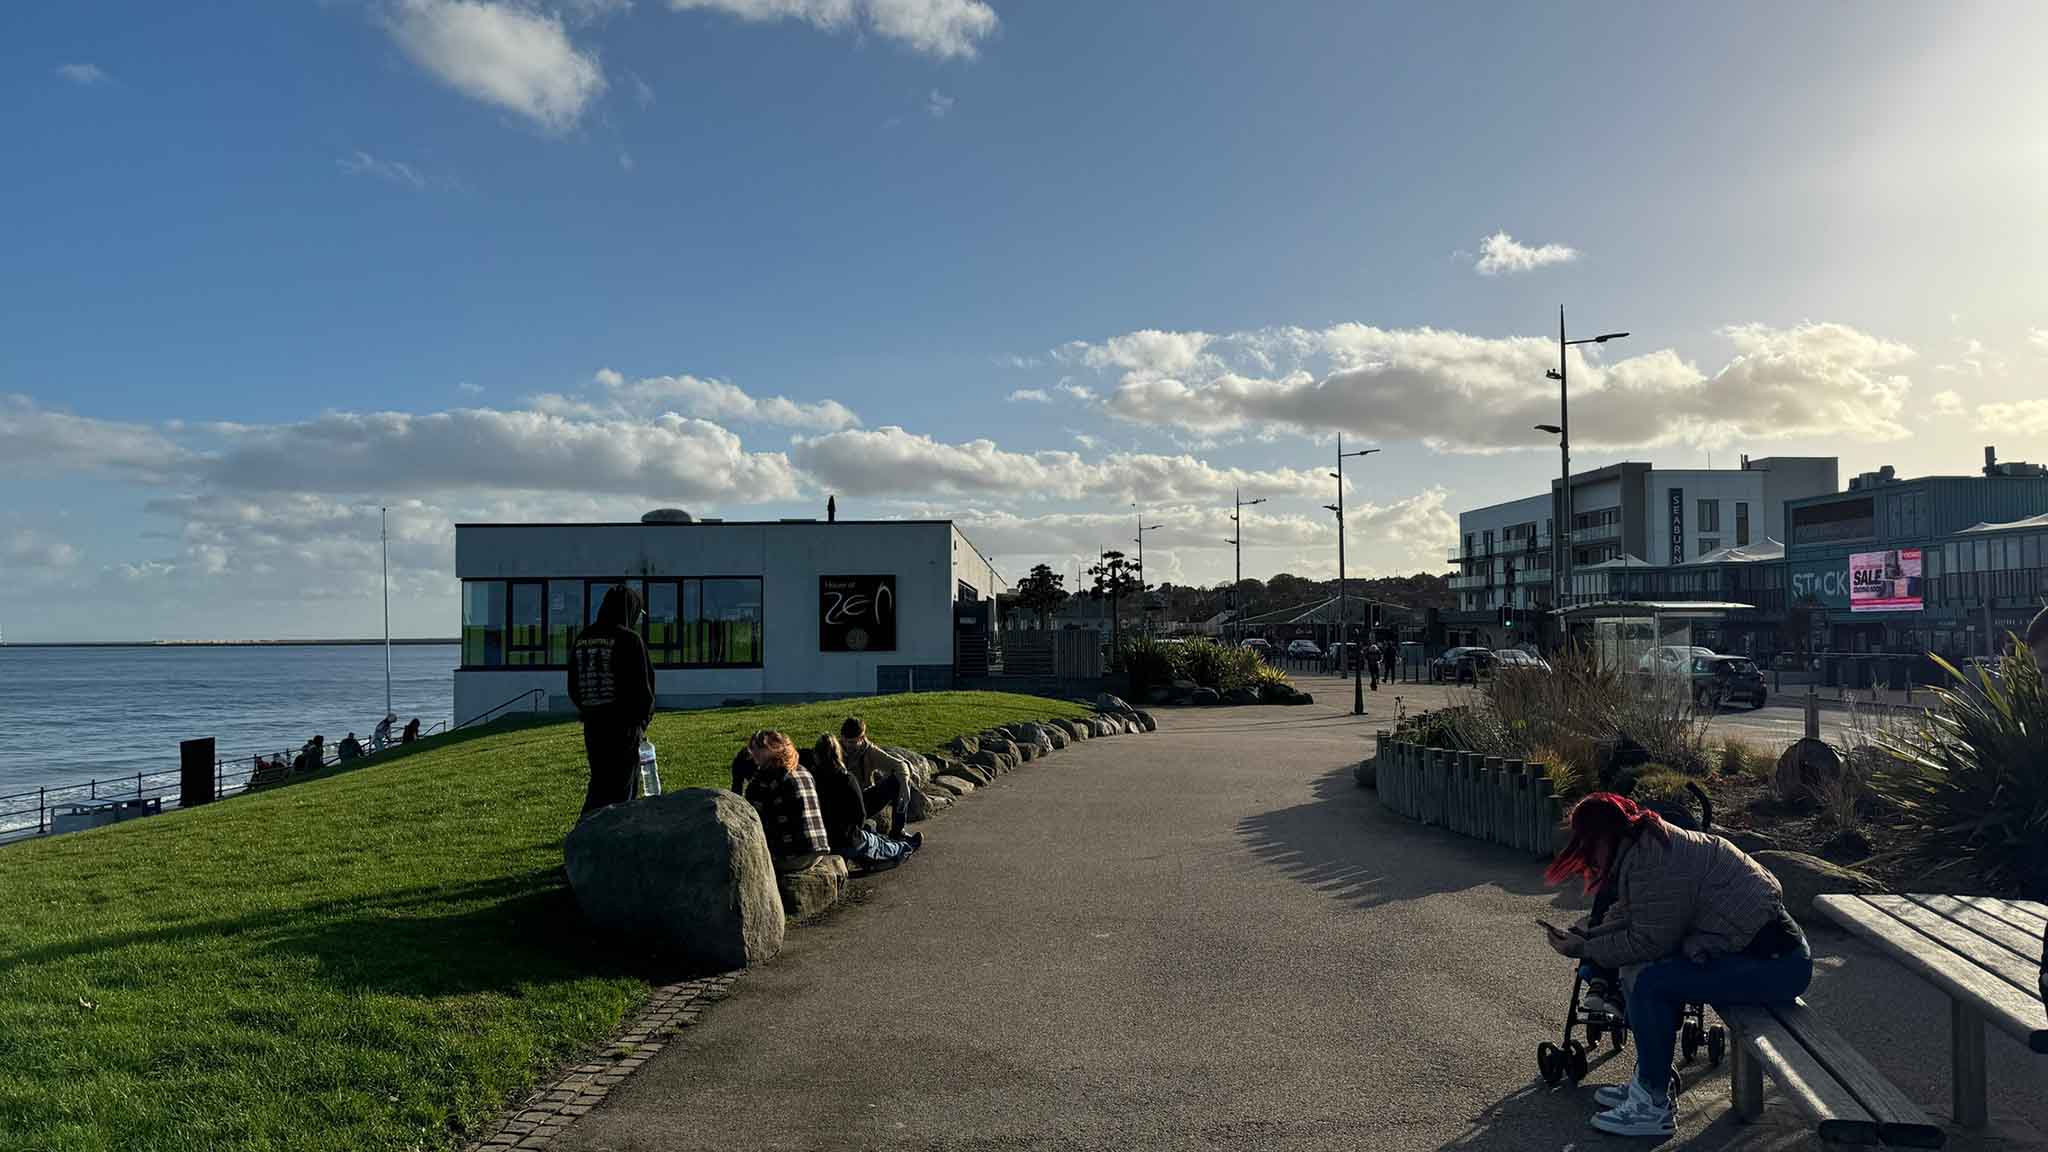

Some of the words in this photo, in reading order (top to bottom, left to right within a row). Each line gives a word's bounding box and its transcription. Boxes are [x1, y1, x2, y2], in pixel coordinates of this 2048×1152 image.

[1672, 495, 1681, 564] SEABURN
[1792, 571, 1848, 597] STACK
[1853, 569, 1882, 586] SALE
